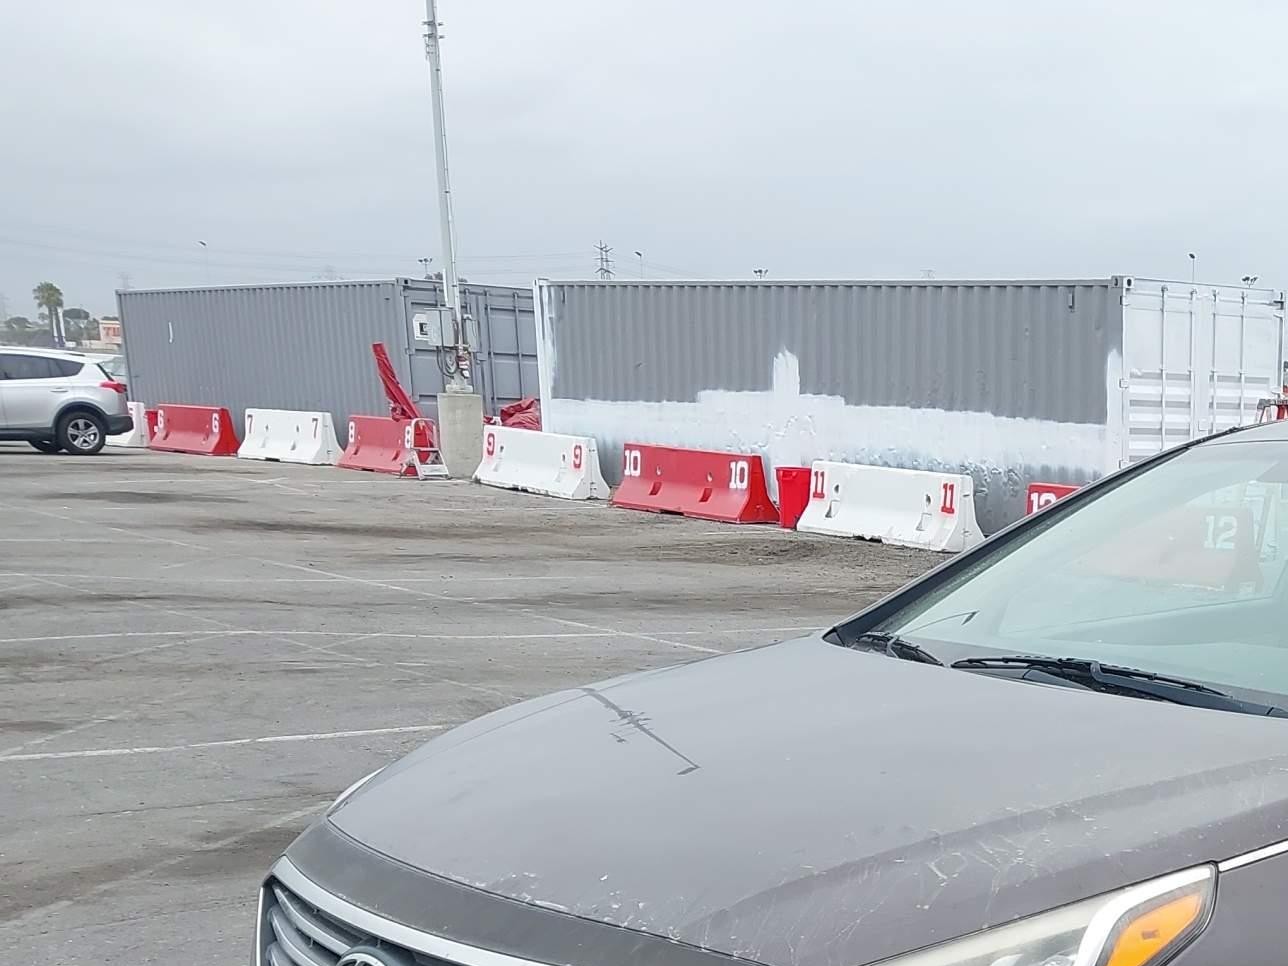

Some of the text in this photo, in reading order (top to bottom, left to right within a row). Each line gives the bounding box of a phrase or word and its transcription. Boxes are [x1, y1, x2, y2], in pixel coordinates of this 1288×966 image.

[211, 414, 219, 432] 6
[247, 414, 253, 434] 7
[312, 417, 319, 438] 7
[348, 421, 355, 443] 8
[486, 432, 496, 456] 9
[572, 444, 583, 469] 9
[624, 449, 641, 477] 10
[728, 460, 749, 489] 10
[812, 470, 826, 499] 11
[941, 482, 955, 514] 11
[1204, 515, 1238, 550] 12
